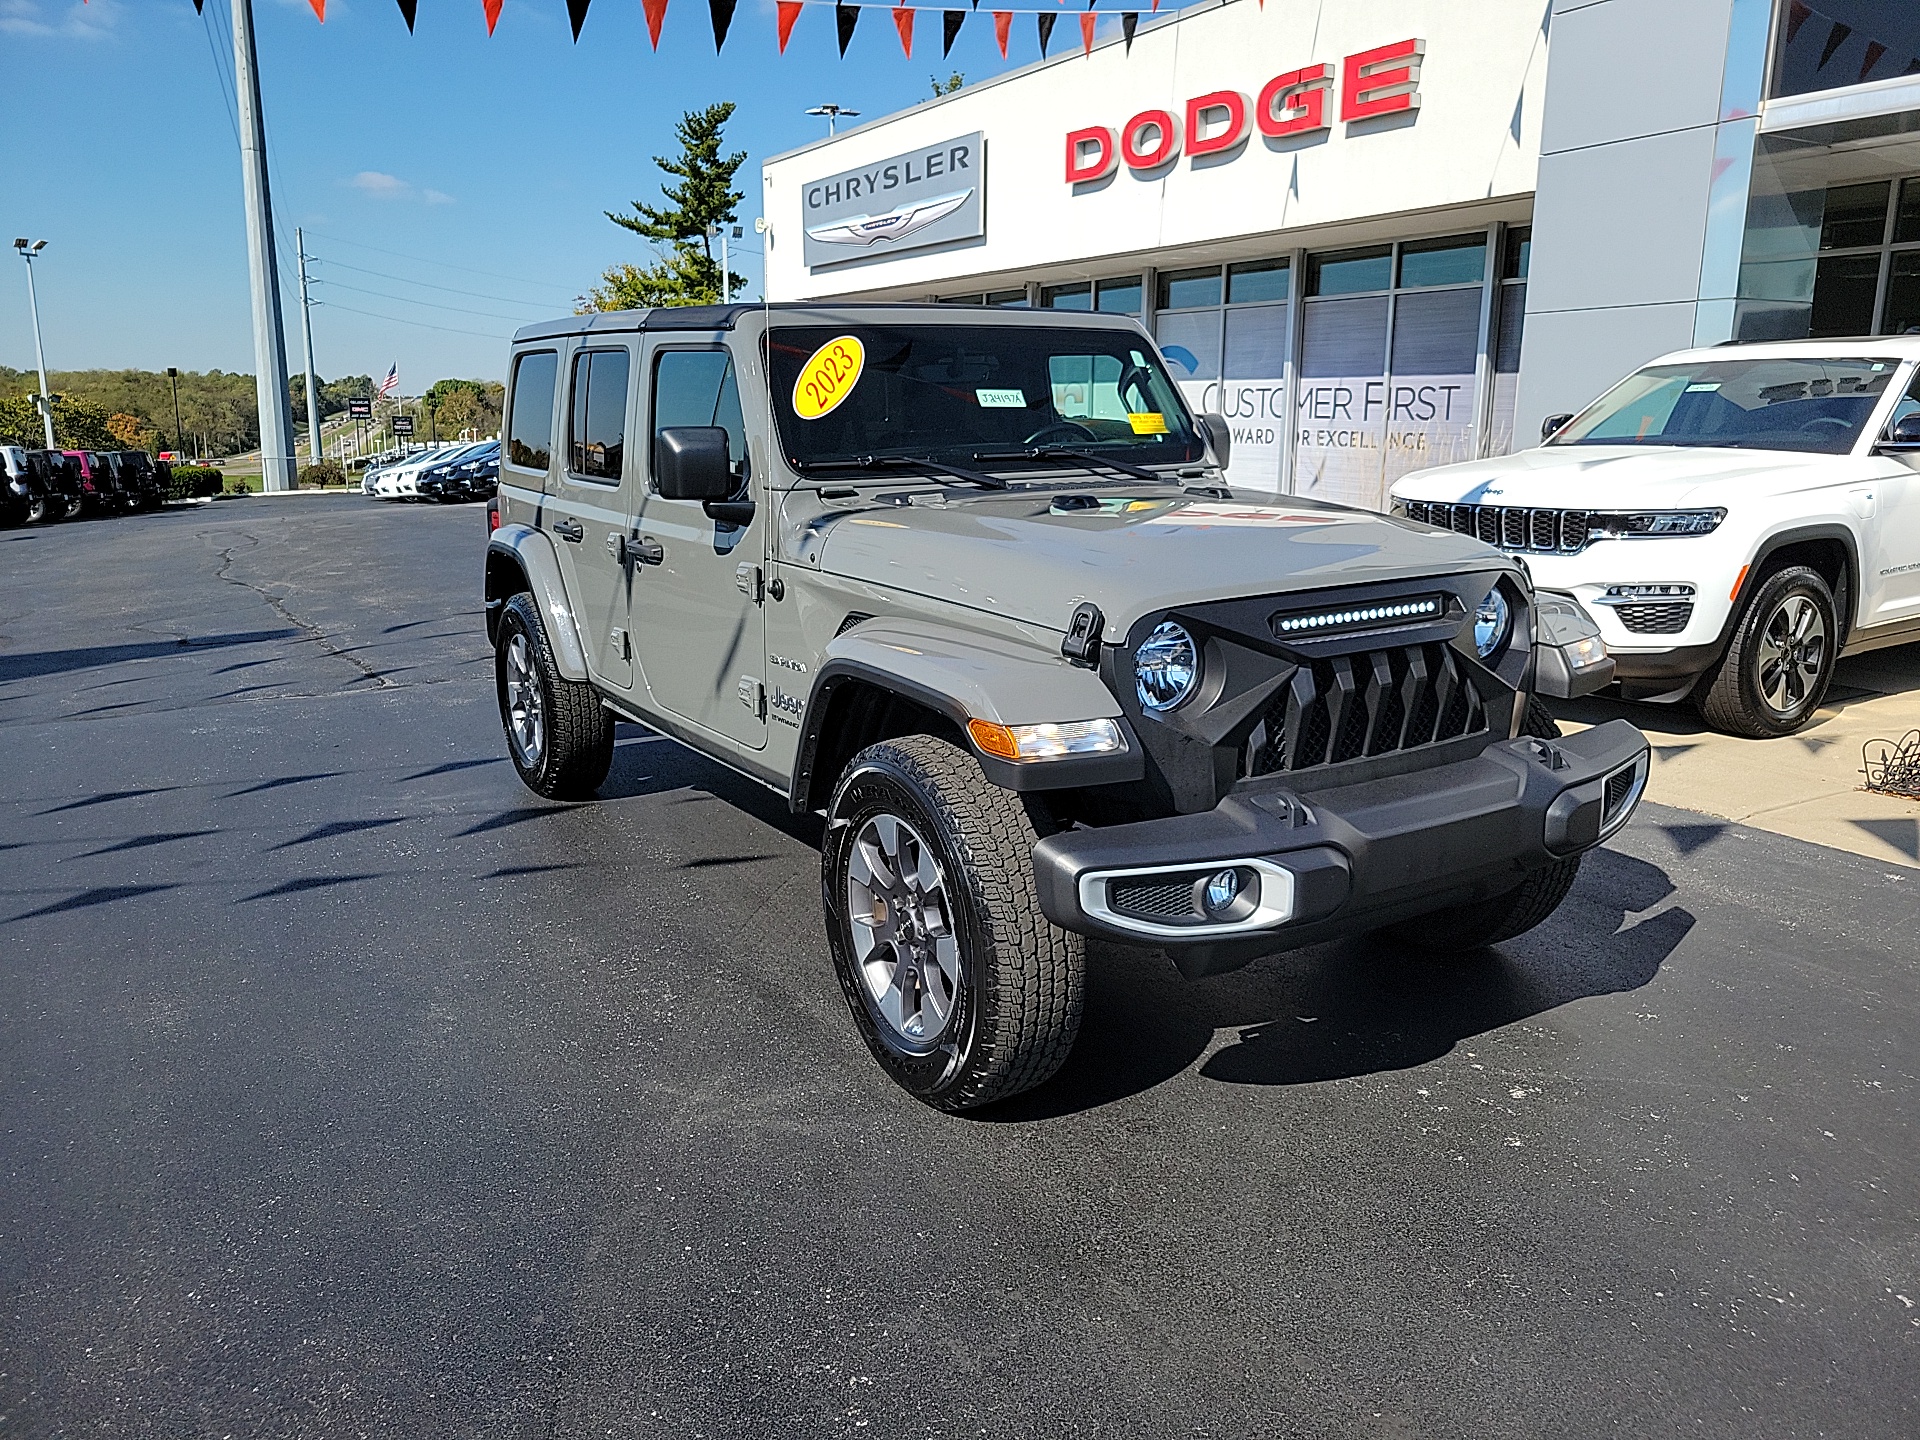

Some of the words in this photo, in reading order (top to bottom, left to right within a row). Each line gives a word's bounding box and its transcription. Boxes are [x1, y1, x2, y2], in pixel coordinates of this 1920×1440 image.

[1065, 38, 1425, 183] DODGE
[808, 145, 970, 208] CHRYSLER
[805, 345, 854, 409] 2023
[1229, 428, 1275, 445] WARD
[770, 685, 806, 721] Jeep
